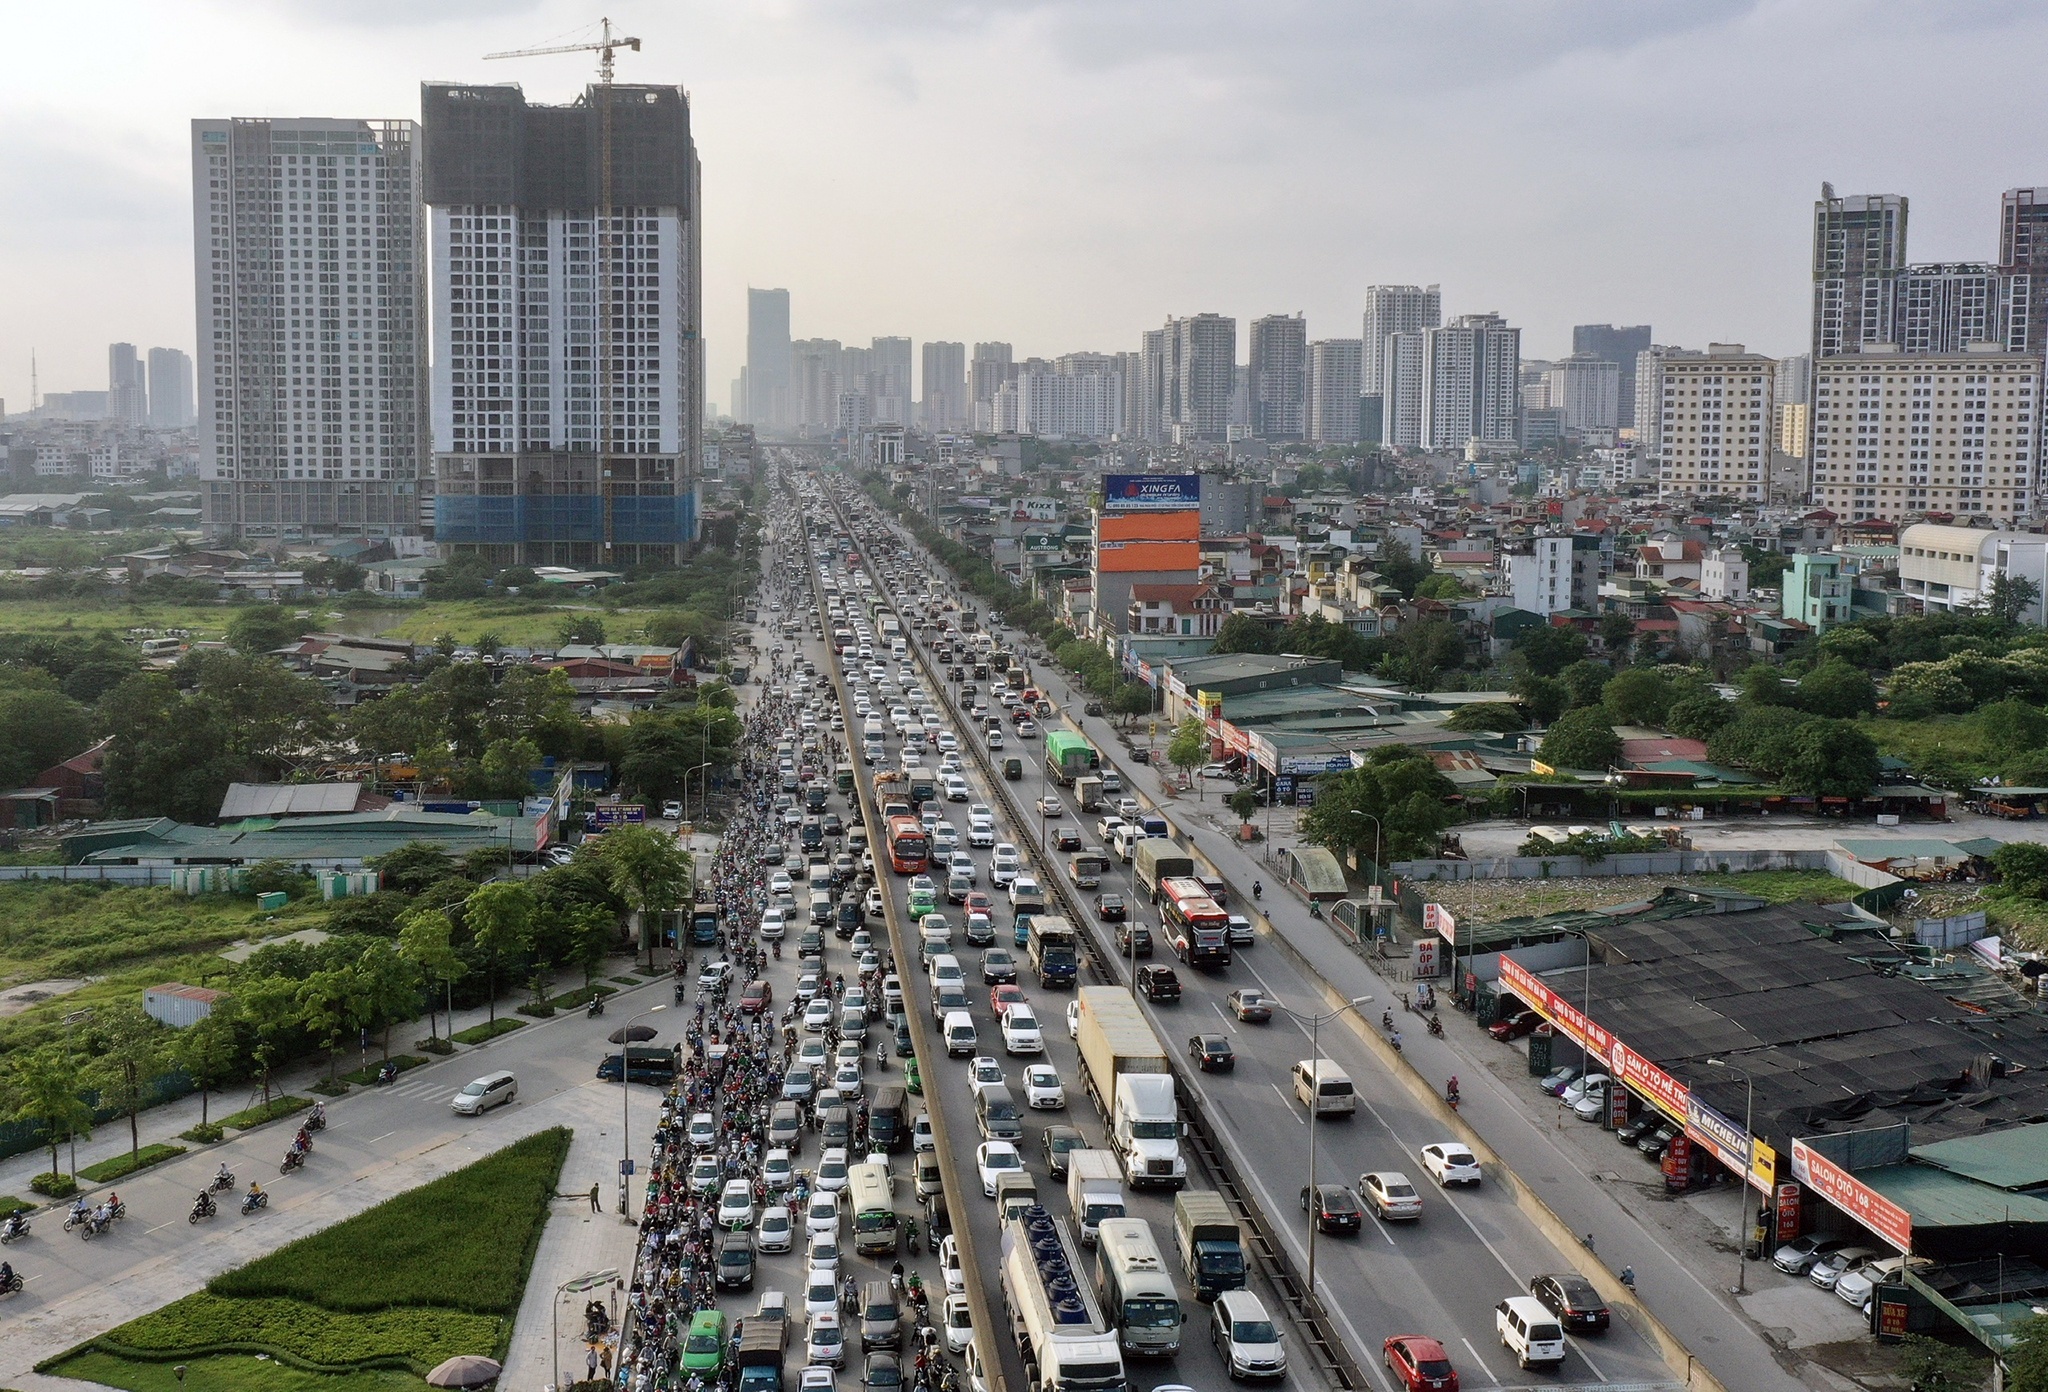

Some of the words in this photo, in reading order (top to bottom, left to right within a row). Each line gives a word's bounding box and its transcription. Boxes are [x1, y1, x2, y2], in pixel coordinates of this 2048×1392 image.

[1140, 484, 1180, 492] XINGFA
[1420, 942, 1432, 952] ĐÁ
[1420, 953, 1432, 963] ỐP
[1418, 965, 1434, 975] LÁT
[1596, 1031, 1606, 1046] NỘI
[1627, 1054, 1641, 1072] SÀN
[1642, 1064, 1648, 1077] Ô
[1650, 1071, 1660, 1086] TÔ
[1701, 1113, 1747, 1155] MICHELIN
[1811, 1159, 1835, 1185] SALON
[1837, 1176, 1853, 1198] ÔTÔ
[1855, 1189, 1869, 1207] 168
[1782, 1209, 1795, 1217] ÔTÔ
